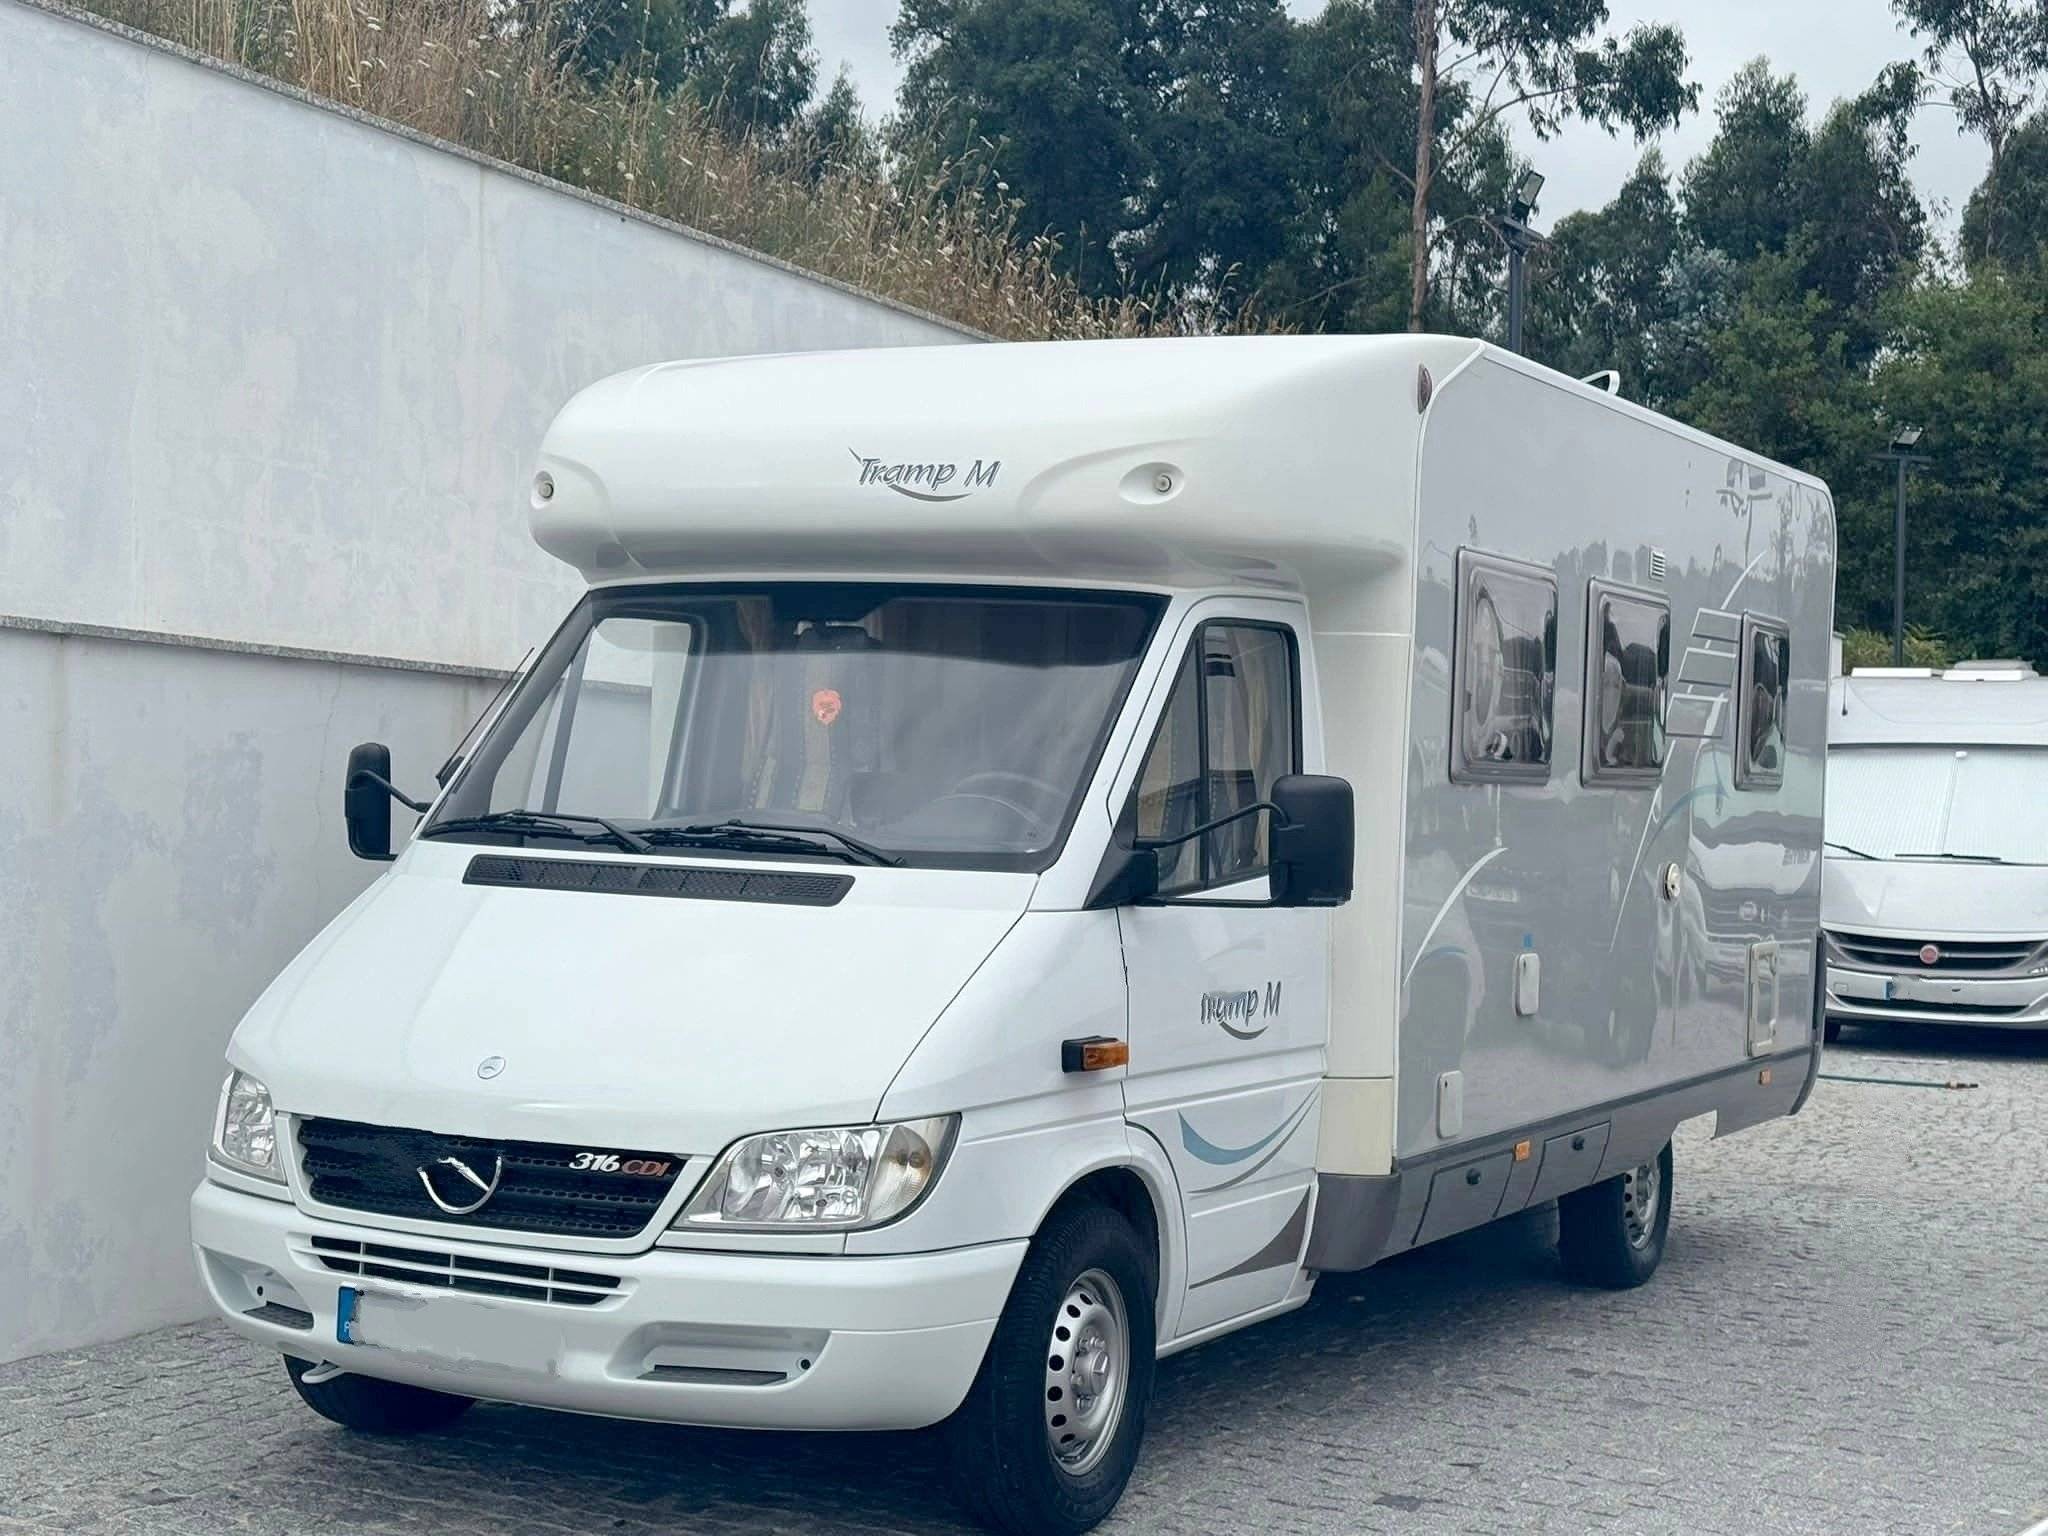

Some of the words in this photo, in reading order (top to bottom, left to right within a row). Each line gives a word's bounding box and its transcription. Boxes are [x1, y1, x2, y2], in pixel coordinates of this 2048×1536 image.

[858, 457, 957, 491] Tramp
[963, 459, 1001, 488] M
[1263, 980, 1281, 1019] M
